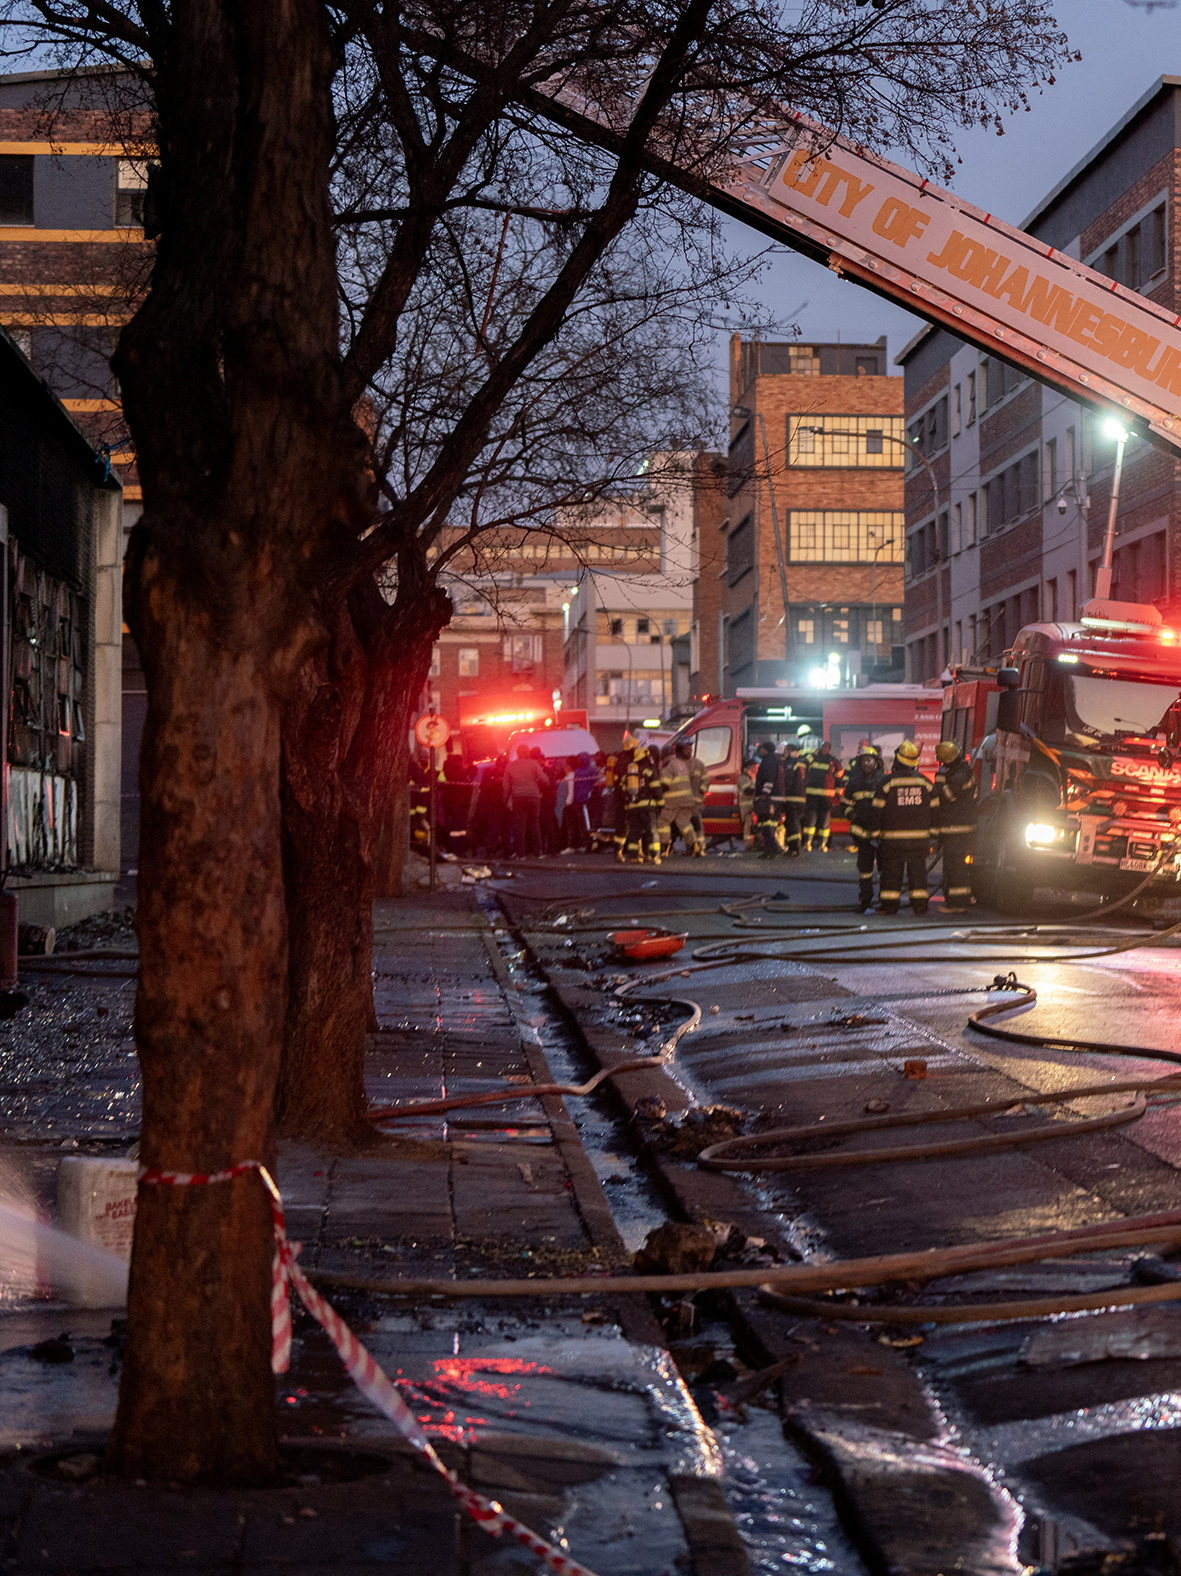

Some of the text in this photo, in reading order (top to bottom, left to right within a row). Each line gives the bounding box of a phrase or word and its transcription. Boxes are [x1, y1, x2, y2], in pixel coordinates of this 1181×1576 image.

[782, 149, 875, 218] CITY
[872, 197, 931, 248] OF
[1110, 761, 1181, 784] SCANIA
[897, 796, 923, 806] EMS
